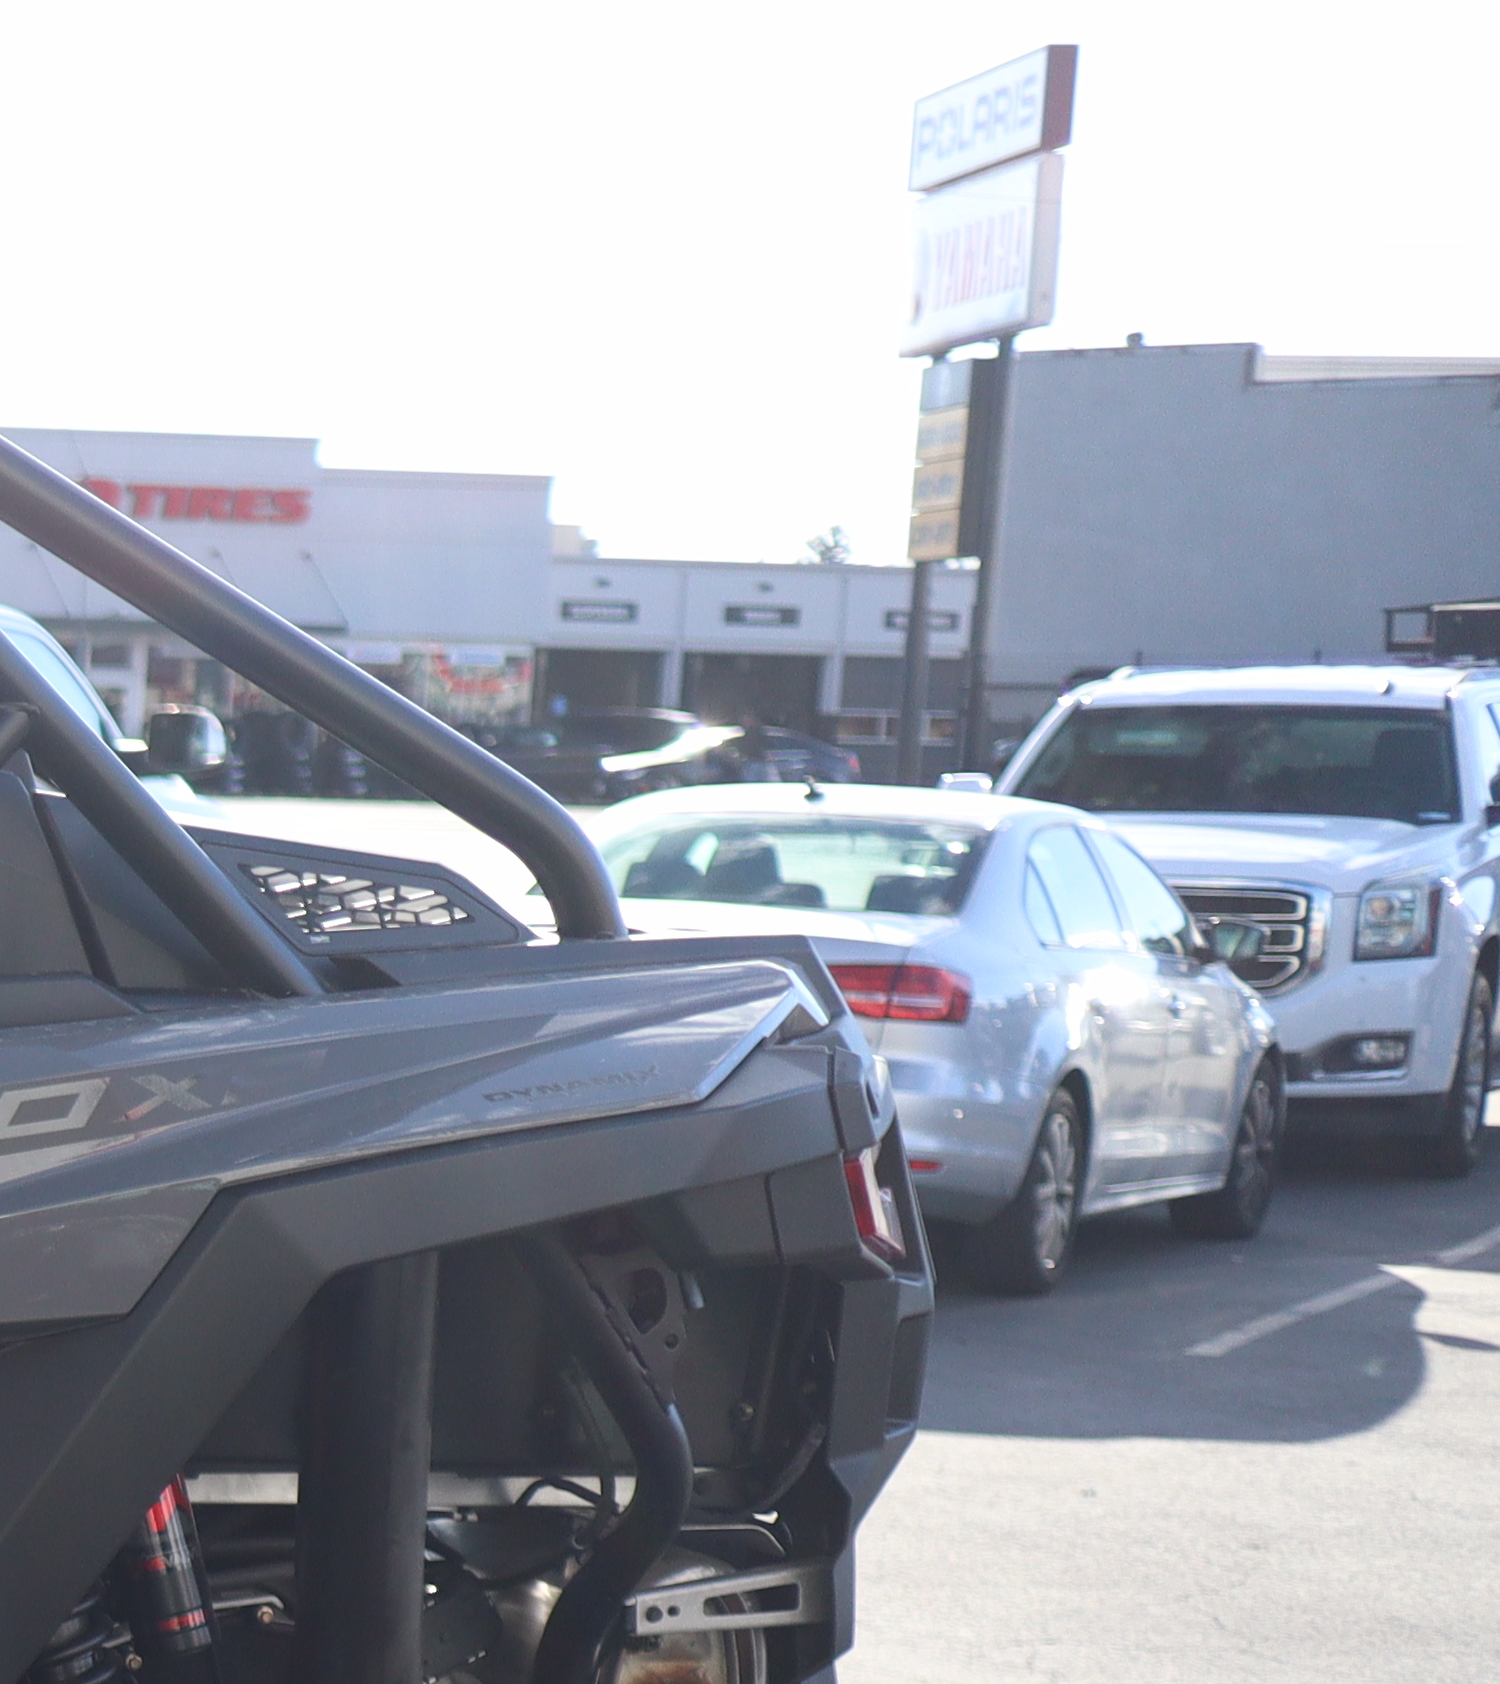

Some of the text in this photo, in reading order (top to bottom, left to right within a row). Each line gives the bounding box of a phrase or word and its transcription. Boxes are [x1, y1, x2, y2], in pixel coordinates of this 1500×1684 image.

[916, 73, 1038, 170] POLARIS
[931, 204, 1028, 314] YAMAHA
[128, 483, 312, 524] TIRES
